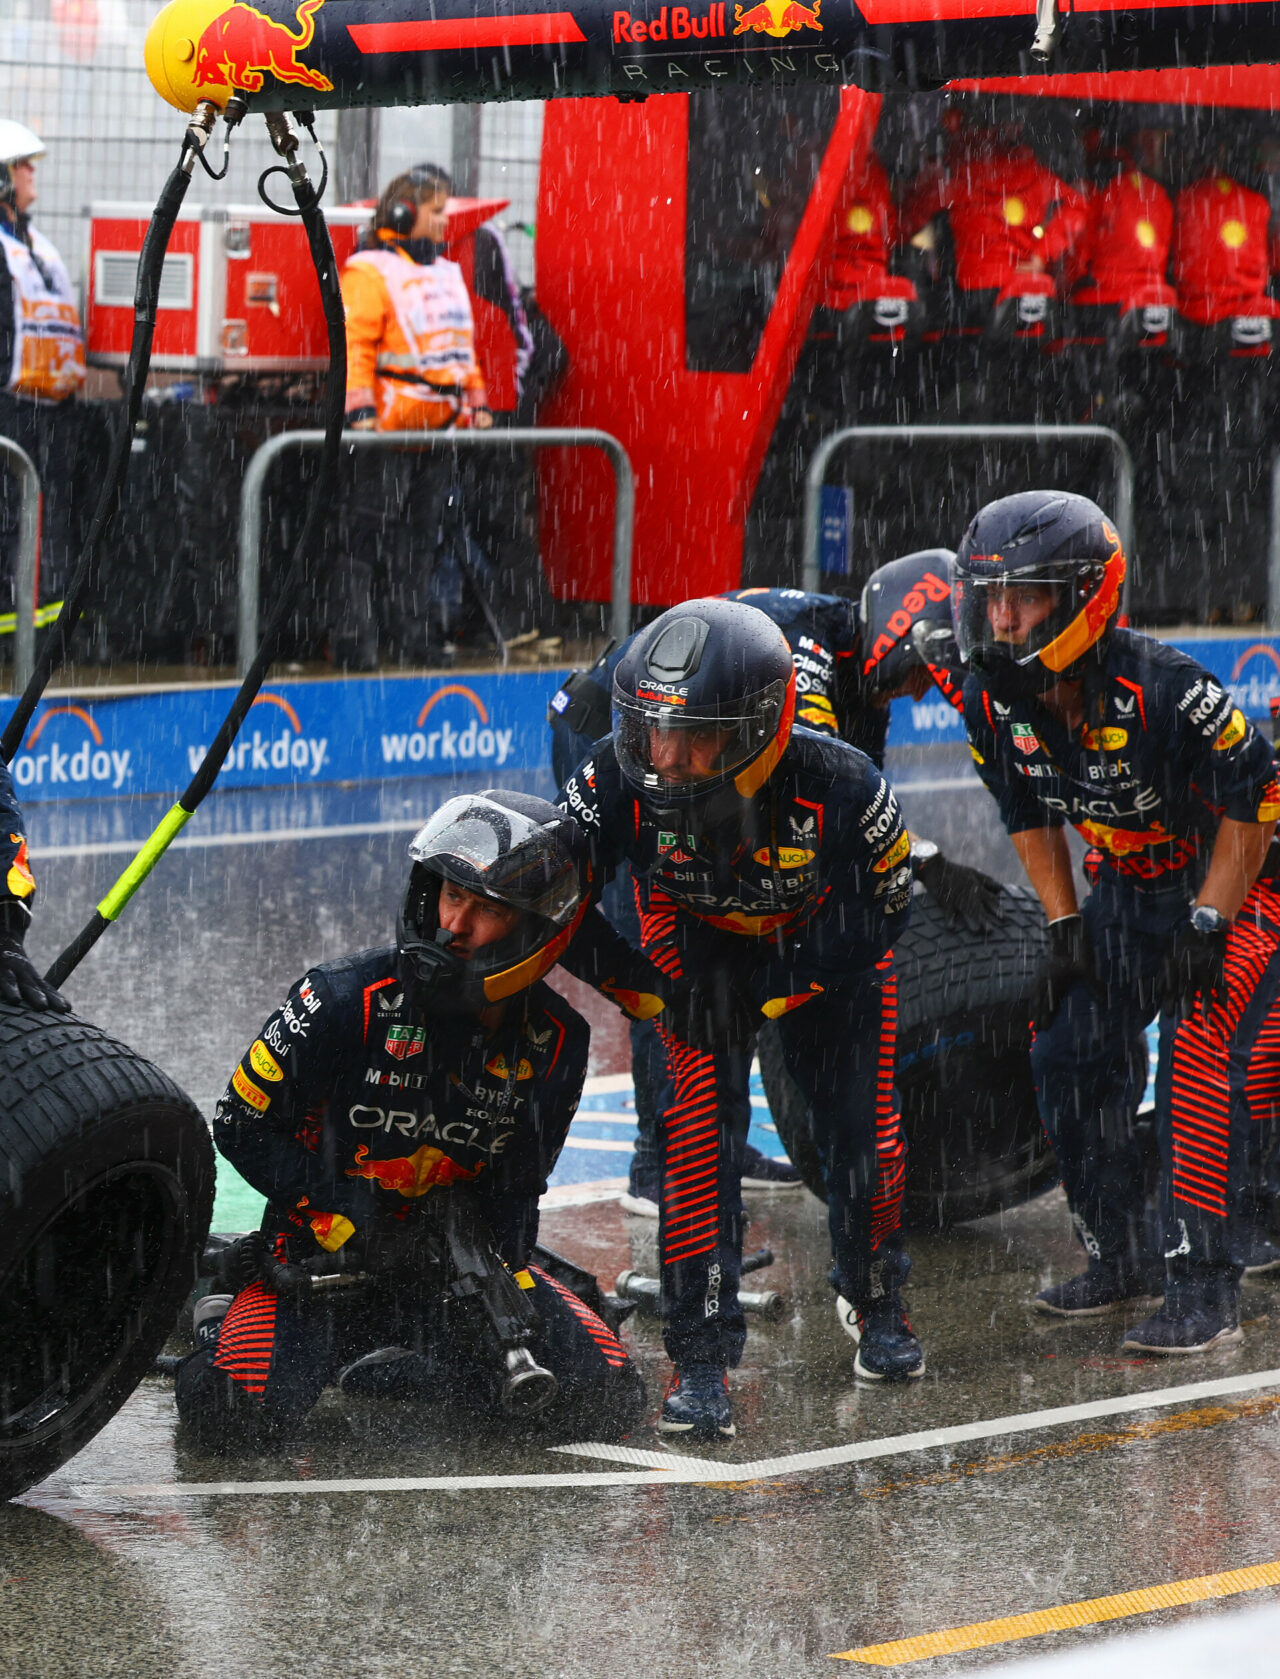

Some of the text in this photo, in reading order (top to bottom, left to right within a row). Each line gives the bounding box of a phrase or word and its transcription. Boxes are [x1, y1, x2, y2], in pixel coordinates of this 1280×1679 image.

[613, 2, 726, 44] Red Bull
[622, 53, 840, 80] RACING
[639, 680, 689, 697] ORACLE
[8, 740, 130, 789] orkday
[566, 777, 601, 827] Claro
[777, 853, 809, 864] AUCH
[269, 1030, 292, 1057] Sui
[349, 1103, 516, 1155] ORACLE
